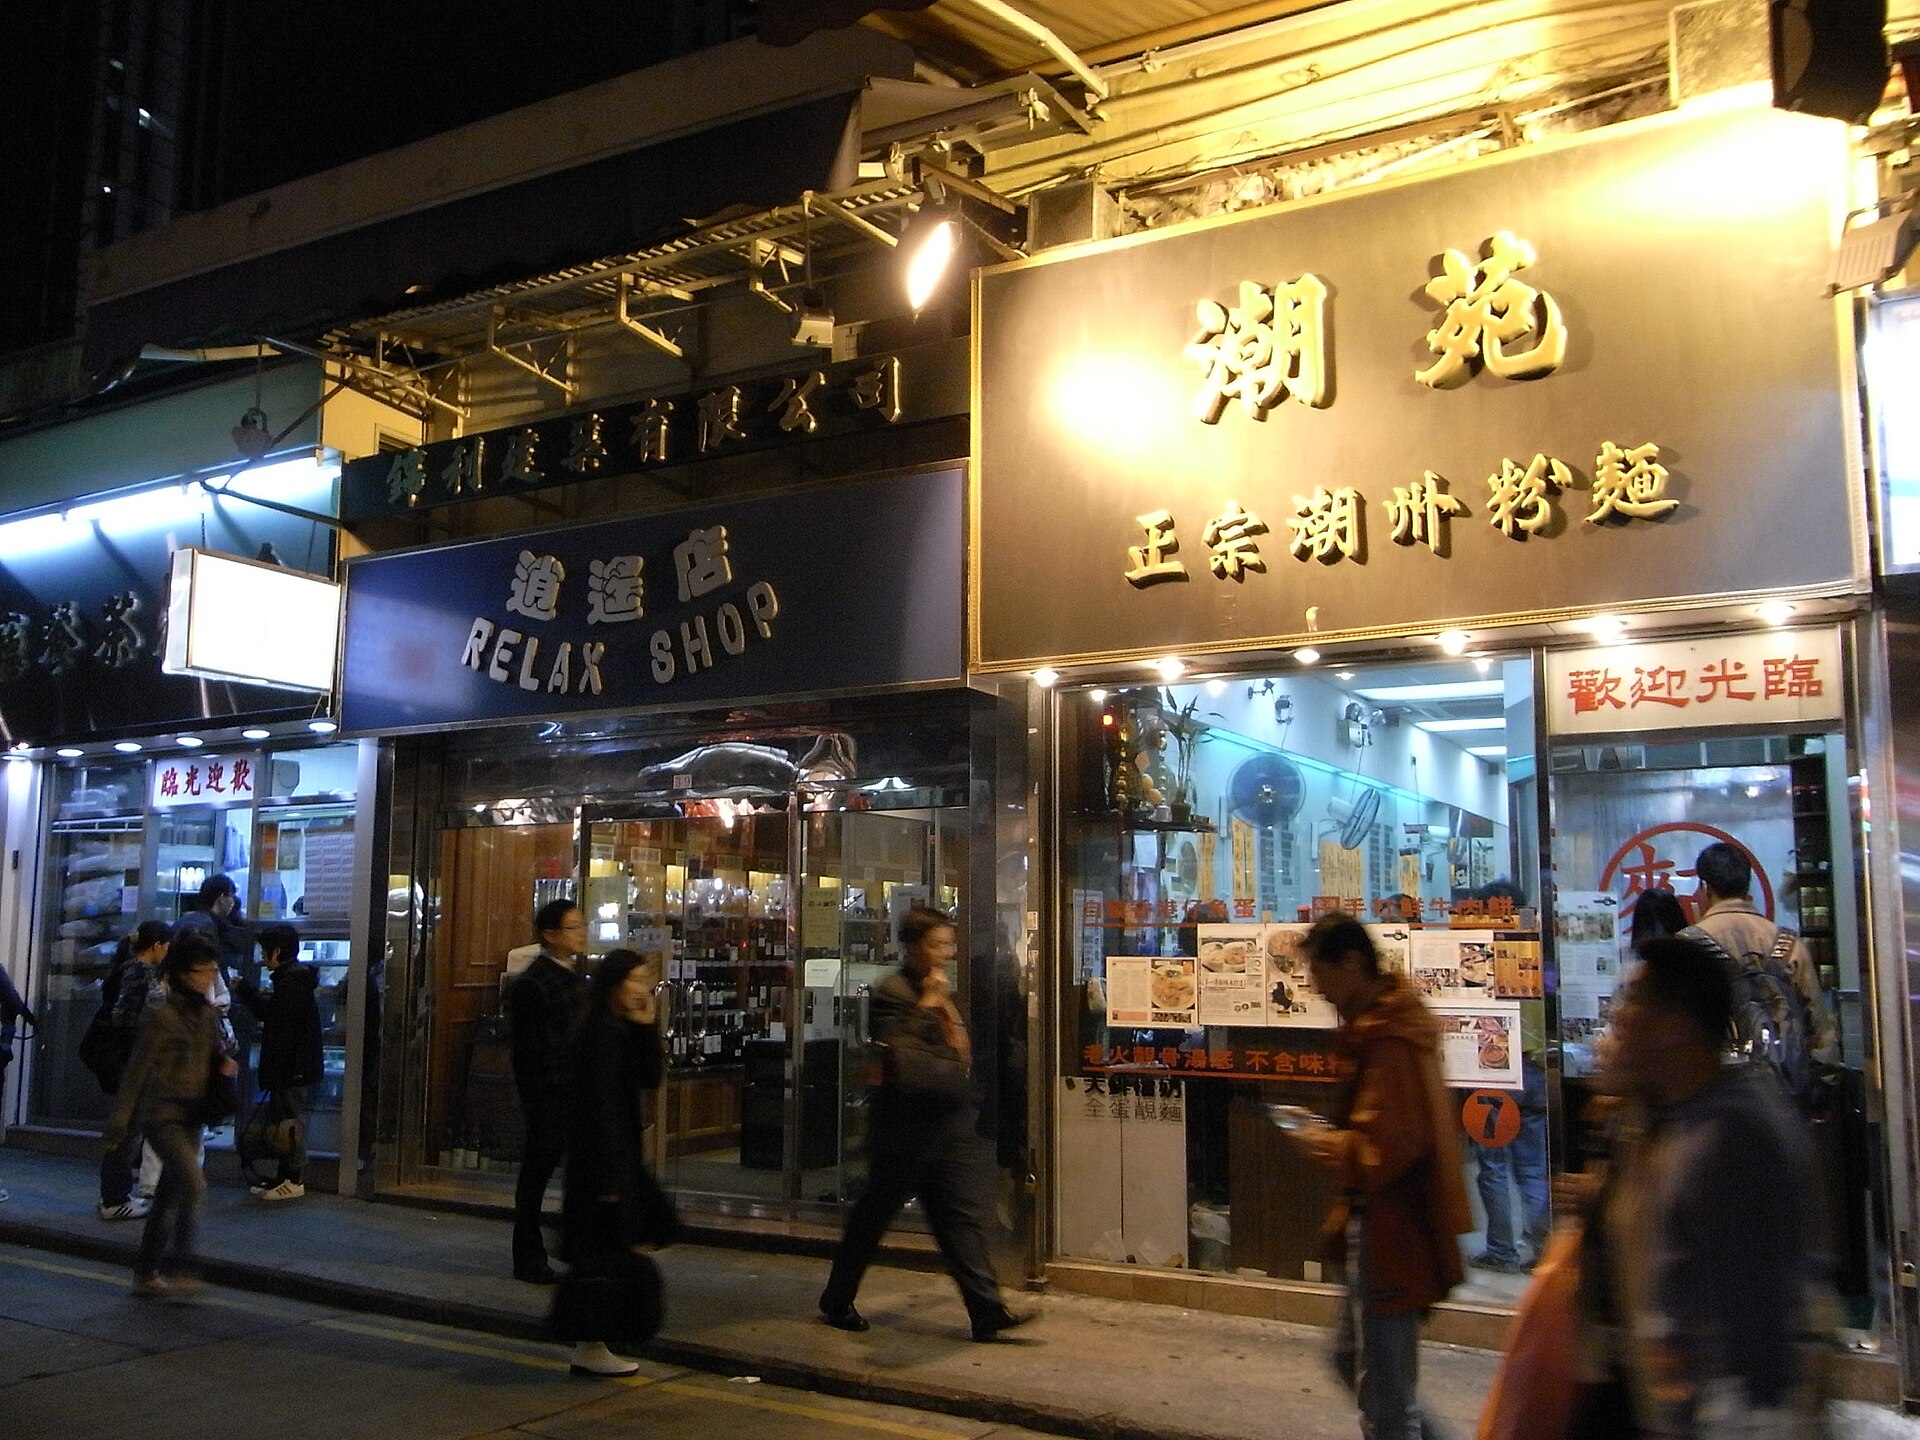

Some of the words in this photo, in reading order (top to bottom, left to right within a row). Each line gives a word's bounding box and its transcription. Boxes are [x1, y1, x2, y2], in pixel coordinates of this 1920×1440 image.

[1185, 230, 1569, 424] 潮苑
[1124, 441, 1681, 589] 正宗潮州粉麵
[461, 617, 606, 696] RELAX
[650, 580, 782, 685] SHOP
[1567, 654, 1824, 716] 歡迎光臨
[1477, 1096, 1504, 1138] 7
